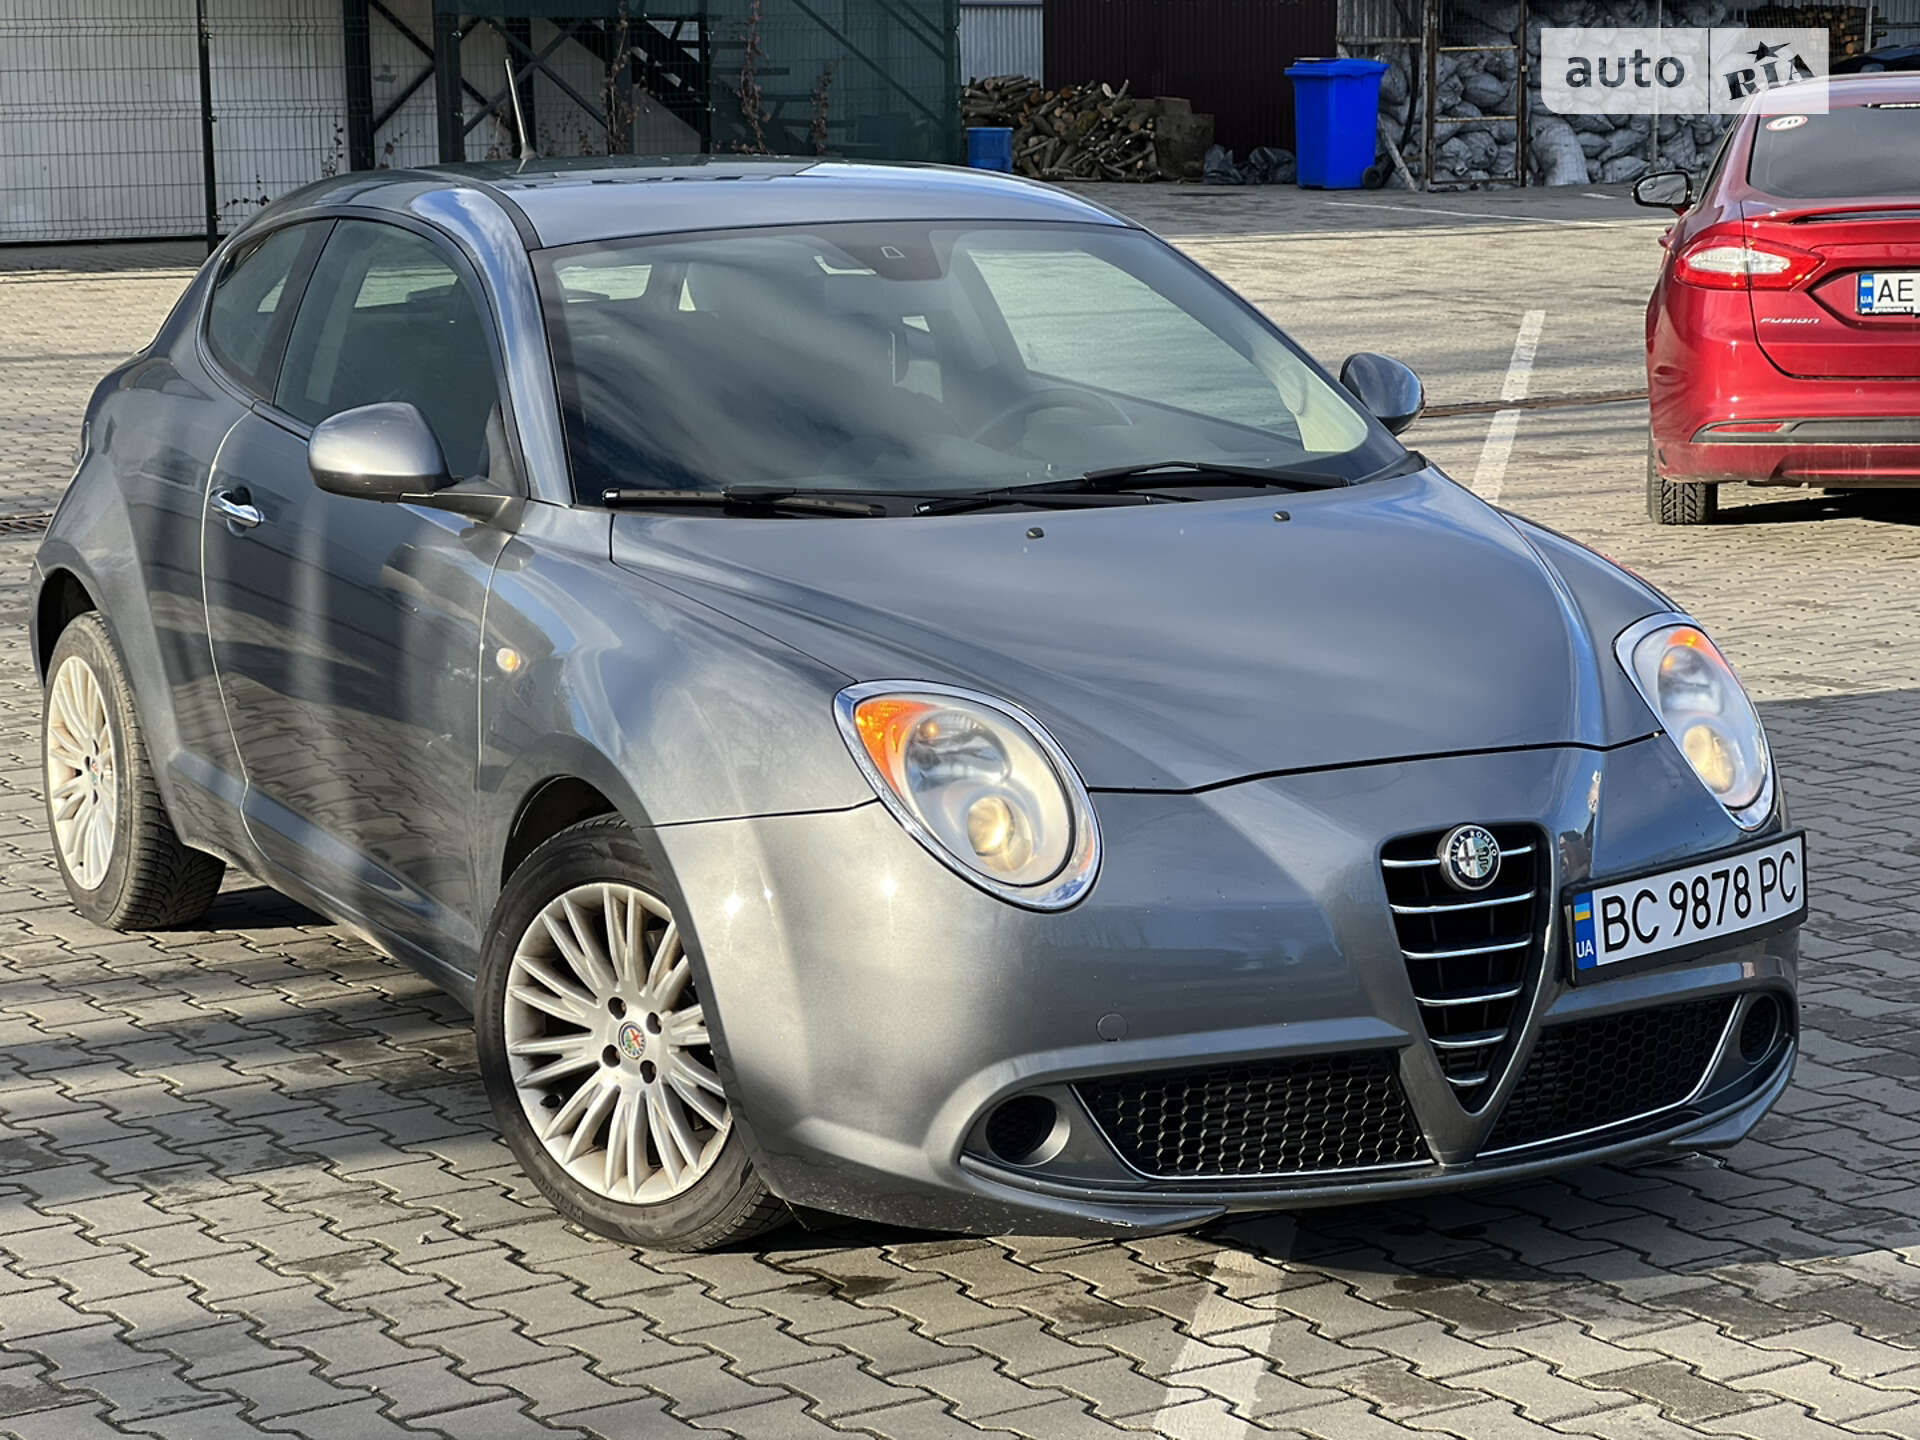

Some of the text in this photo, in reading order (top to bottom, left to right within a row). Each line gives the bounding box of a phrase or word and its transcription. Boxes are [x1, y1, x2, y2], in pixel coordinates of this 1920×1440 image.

[1877, 279, 1914, 302] AE
[1601, 850, 1797, 953] BC 9878 PC
[1576, 939, 1595, 958] UA
